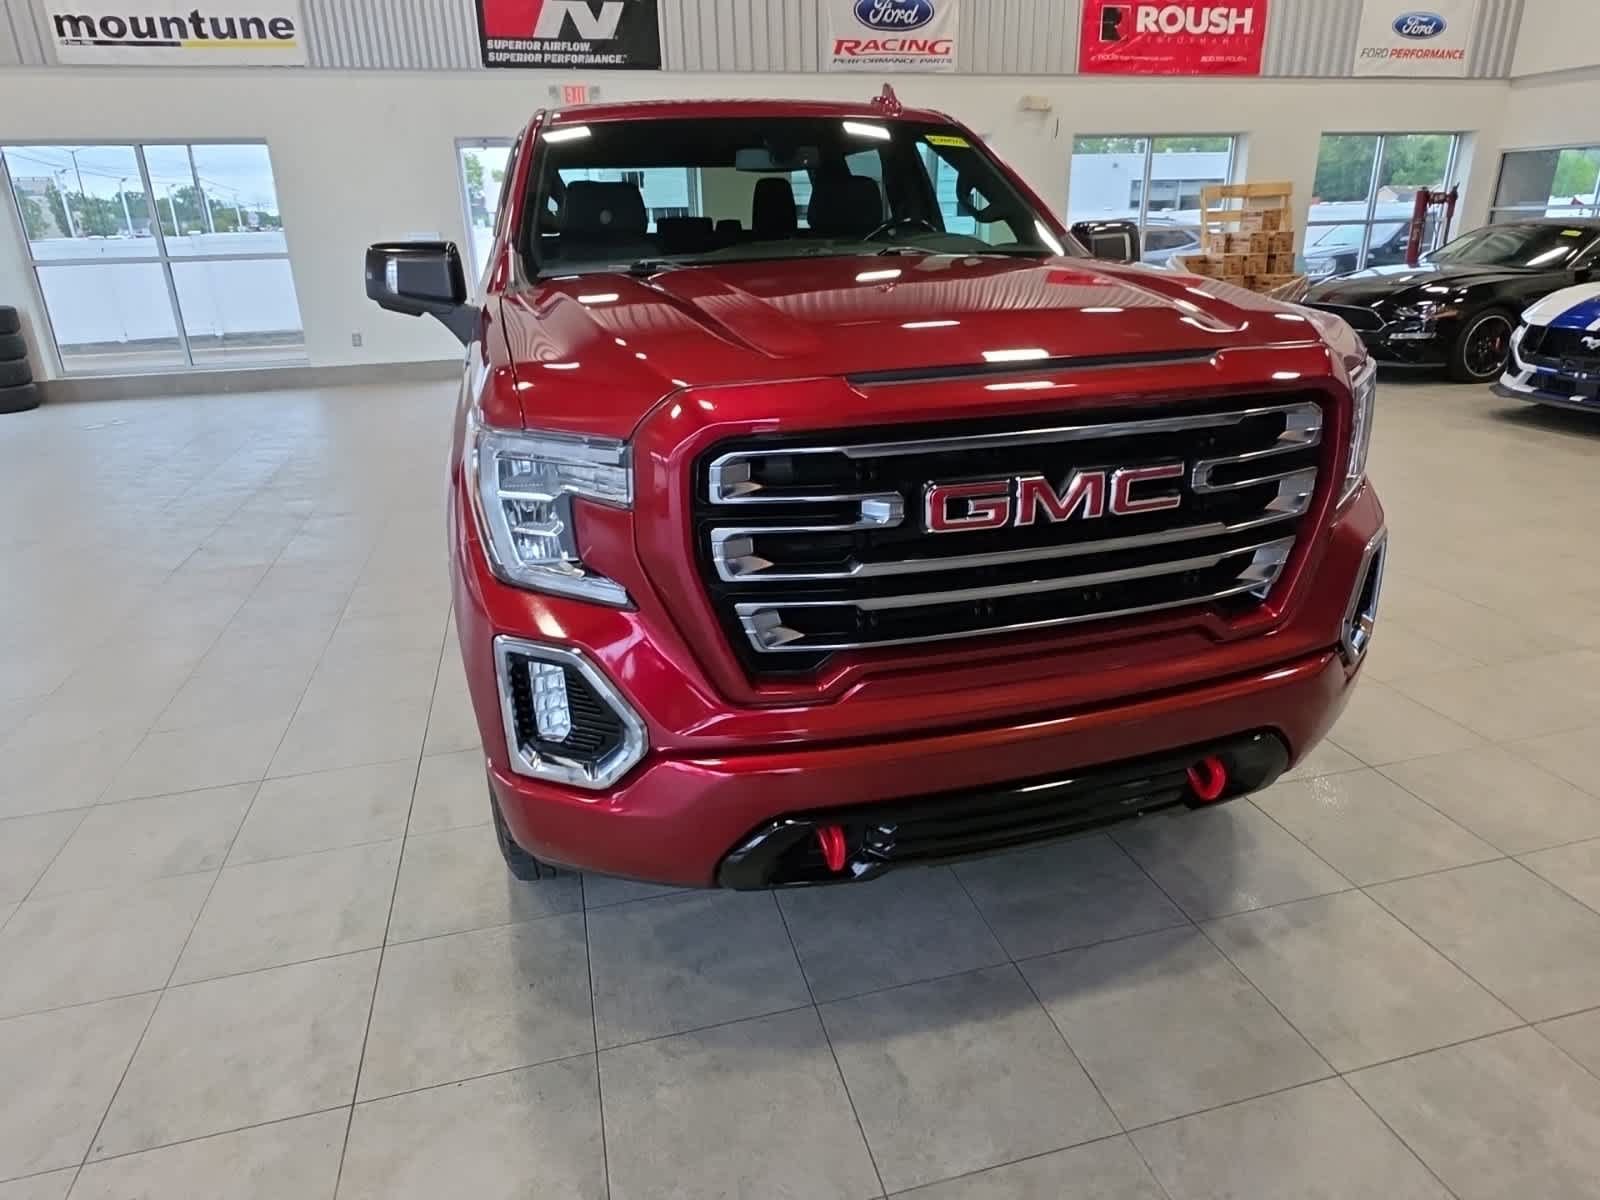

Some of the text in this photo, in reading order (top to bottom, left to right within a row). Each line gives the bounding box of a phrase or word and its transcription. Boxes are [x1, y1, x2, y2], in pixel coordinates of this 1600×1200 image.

[868, 0, 919, 24] Ford
[1136, 5, 1253, 35] ROUSH
[53, 9, 296, 40] mountune
[1402, 16, 1436, 34] Ford
[487, 39, 592, 52] SUPERIOR AIRFLOW.
[833, 38, 953, 56] RACING
[1360, 47, 1465, 60] FORD PERFORMANCE
[488, 52, 542, 62] SUPERIOR
[922, 460, 1185, 534] GMC
